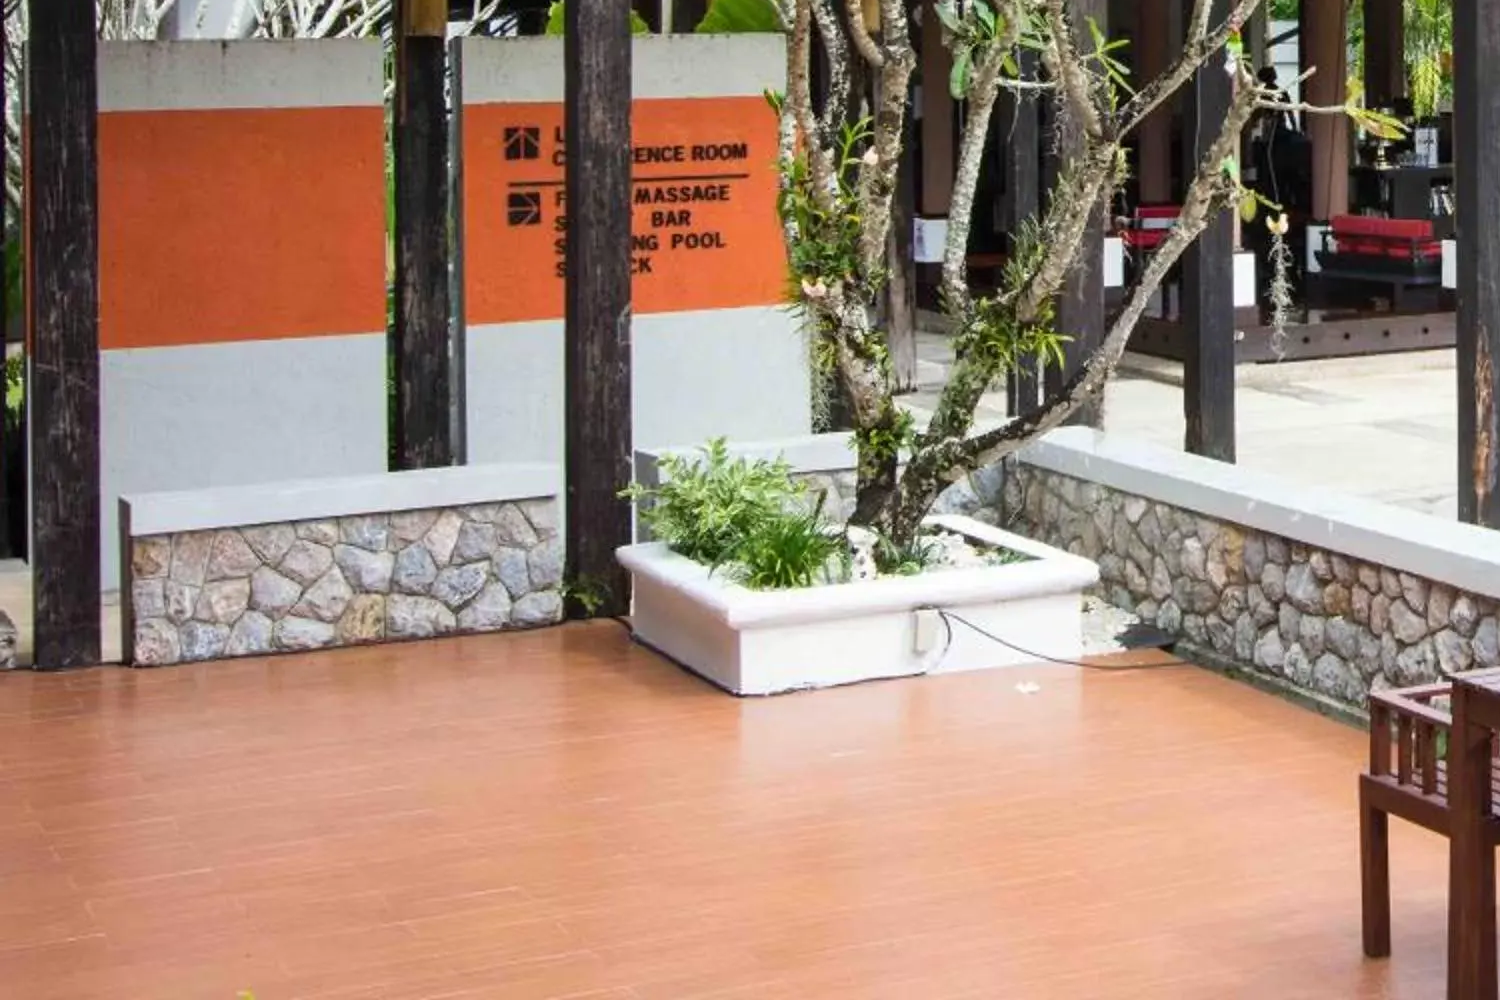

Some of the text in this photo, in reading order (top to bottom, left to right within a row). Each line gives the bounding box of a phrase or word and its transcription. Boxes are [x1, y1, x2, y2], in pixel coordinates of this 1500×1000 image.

[691, 142, 748, 162] ROOM
[634, 184, 731, 204] MASSAGE
[651, 210, 692, 228] BAR
[671, 231, 727, 250] POOL
